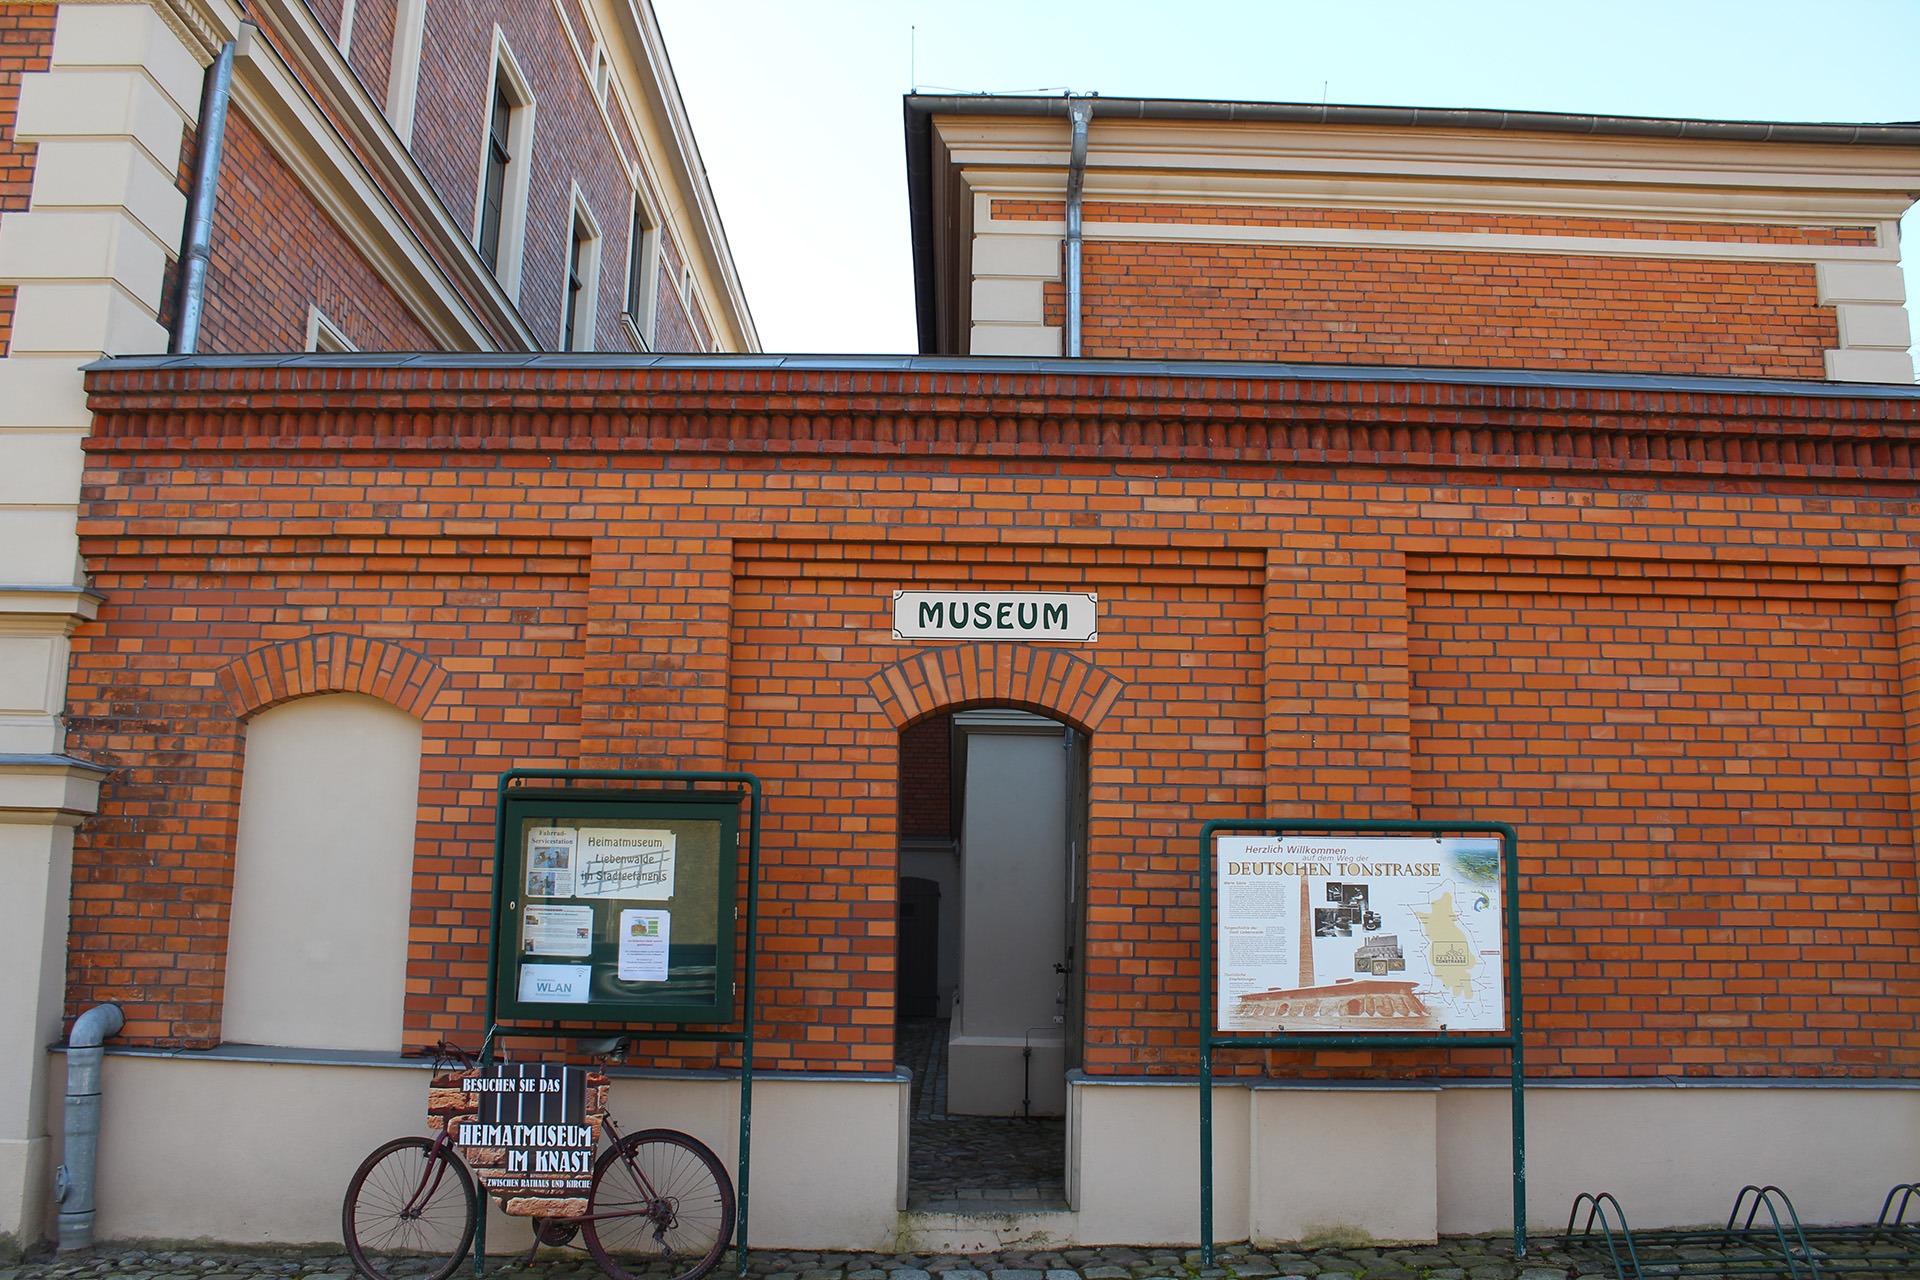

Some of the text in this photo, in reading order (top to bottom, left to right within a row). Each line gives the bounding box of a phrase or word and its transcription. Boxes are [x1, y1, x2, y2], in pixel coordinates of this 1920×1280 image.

[918, 601, 1068, 630] MUSEUM
[588, 837, 662, 848] Heimatmuseum
[1245, 845, 1346, 854] Herzlich Willkommen
[595, 854, 654, 864] Liebenwalde
[1336, 854, 1354, 863] Weg
[1228, 862, 1441, 877] DEUTSCHEN TONSTRASSE
[580, 870, 667, 882] im Stadtgefängnis
[536, 982, 572, 992] WLAN
[462, 1078, 560, 1093] BESUCHEN SIE DAS
[459, 1124, 592, 1147] HEIMATMUSEUM
[508, 1150, 591, 1173] IM KNAST
[487, 1178, 591, 1188] ZWISCHEN RATHAUS UND KIRCHE
